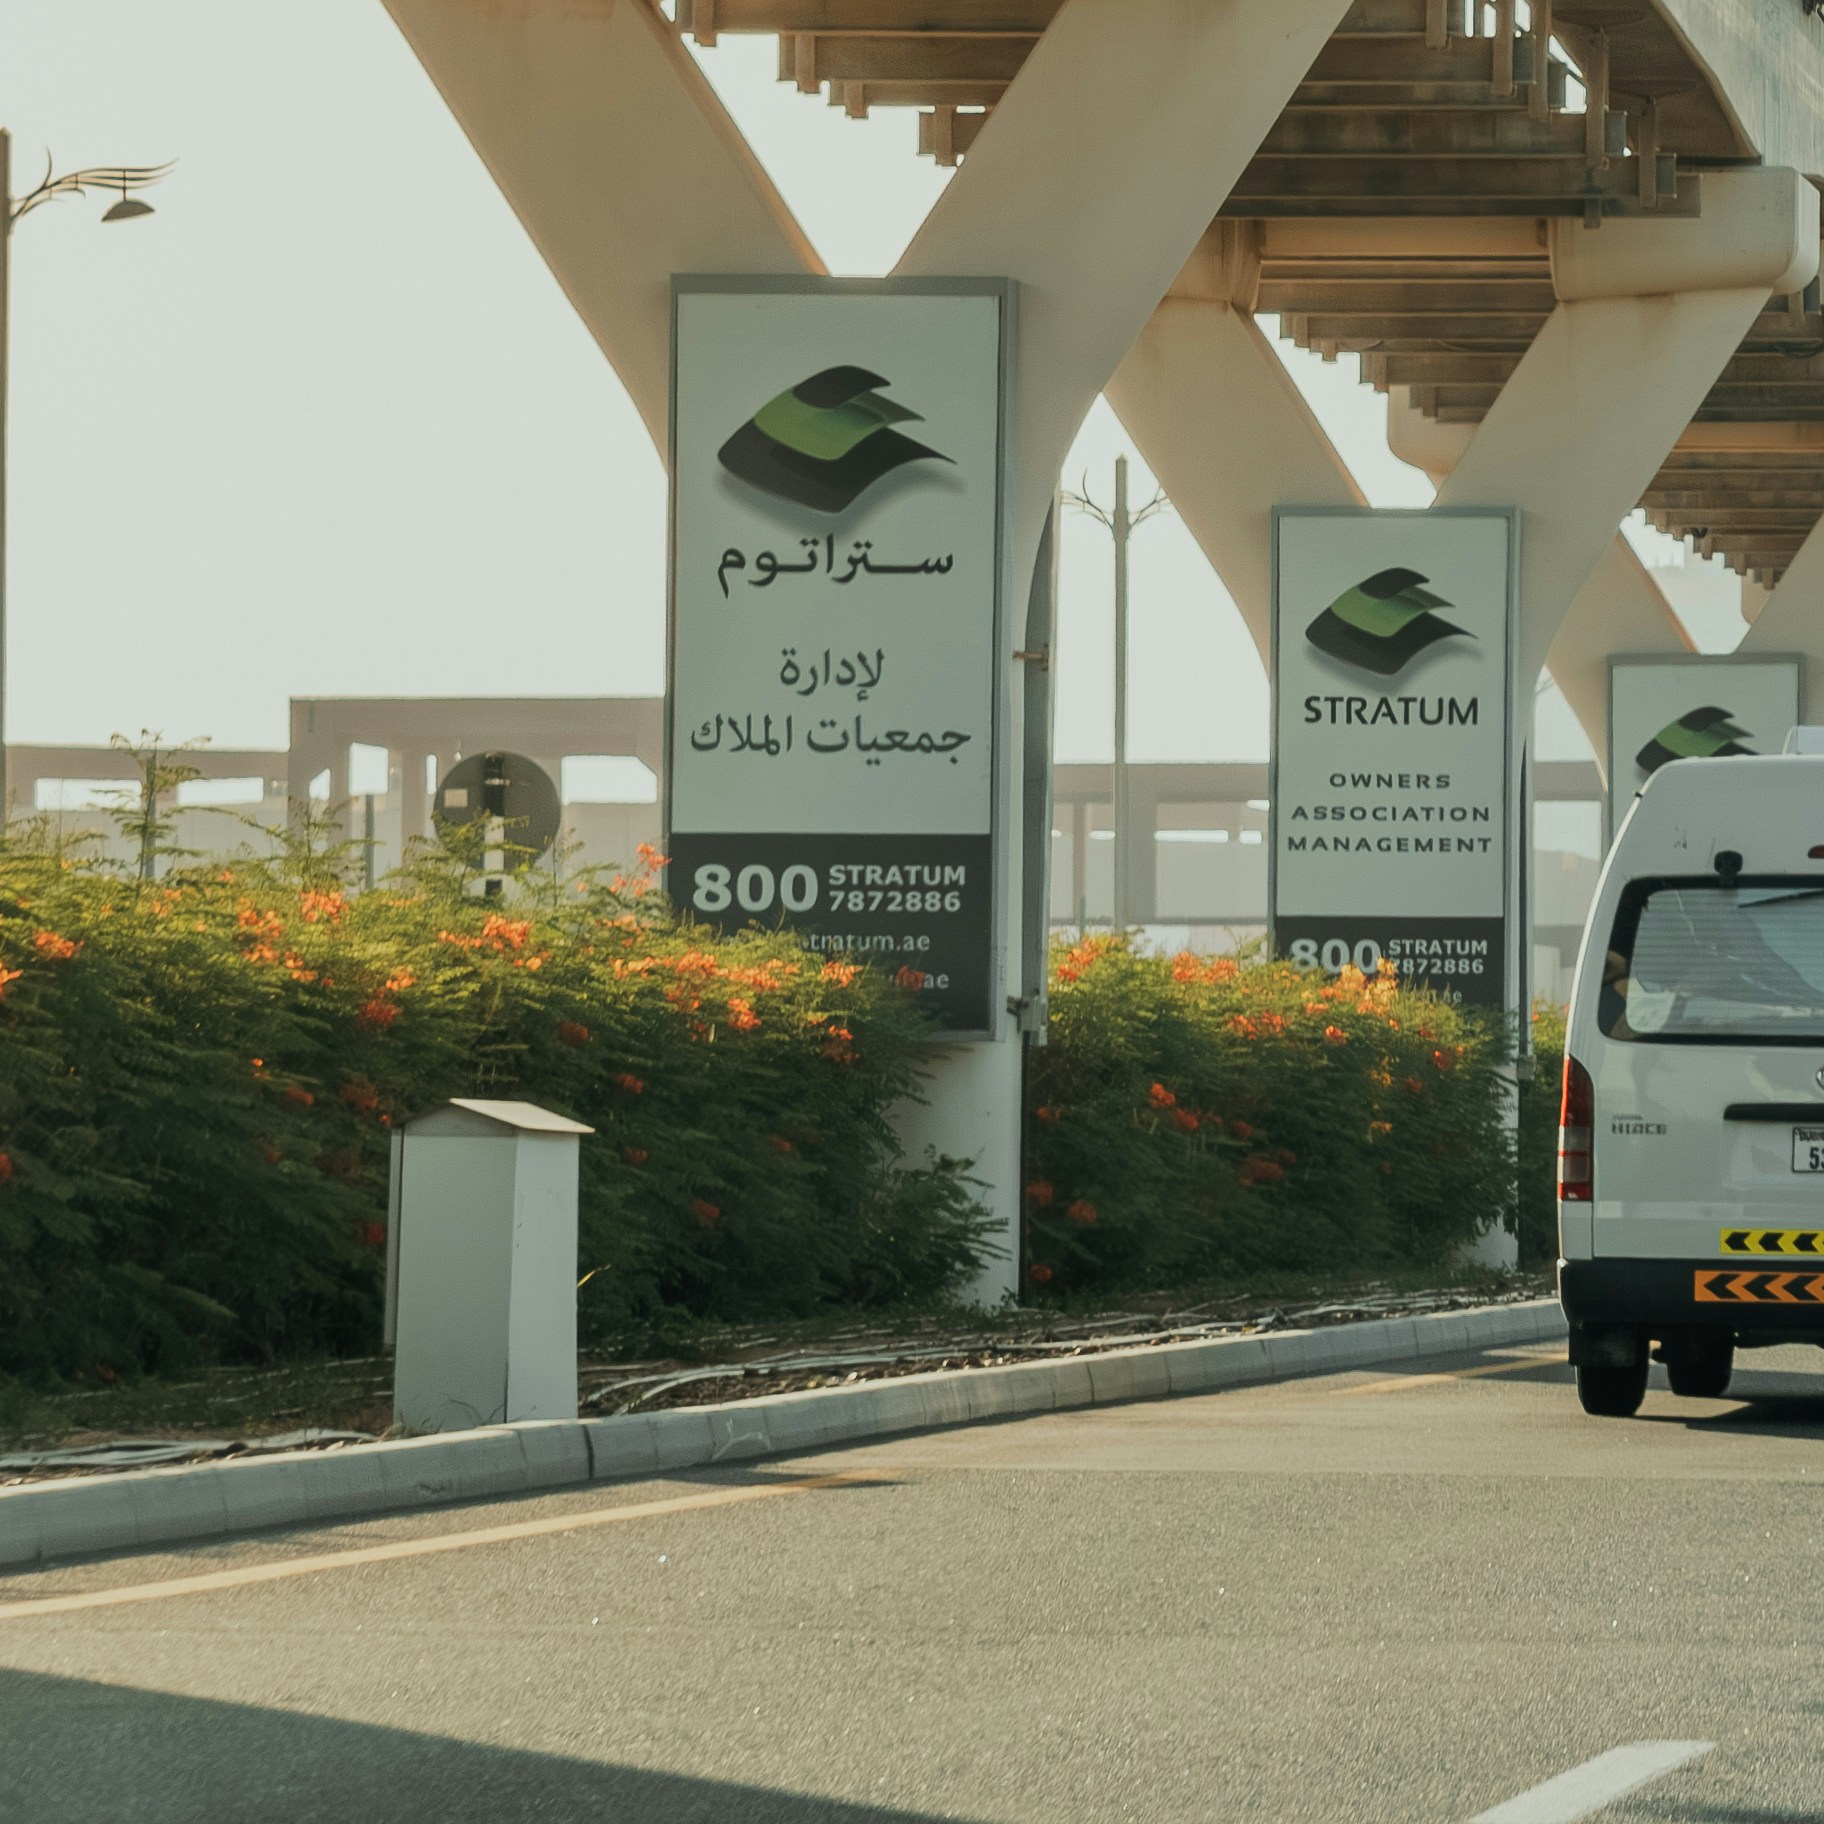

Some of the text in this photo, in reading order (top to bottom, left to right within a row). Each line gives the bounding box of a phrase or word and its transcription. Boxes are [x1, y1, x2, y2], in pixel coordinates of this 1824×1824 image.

[718, 533, 953, 599] ستراتوم
[780, 648, 884, 702] لإدارة
[1304, 696, 1479, 726] STRATUM
[690, 713, 972, 766] جمعيات الملاك
[1329, 773, 1451, 790] OWNERS
[1291, 806, 1490, 823] ASSOCIATION
[1287, 837, 1492, 854] MANAGEMENT
[693, 863, 966, 912] 800 STRATUM
[828, 890, 961, 913] 7872886
[1290, 938, 1488, 975] 800 STRATUM
